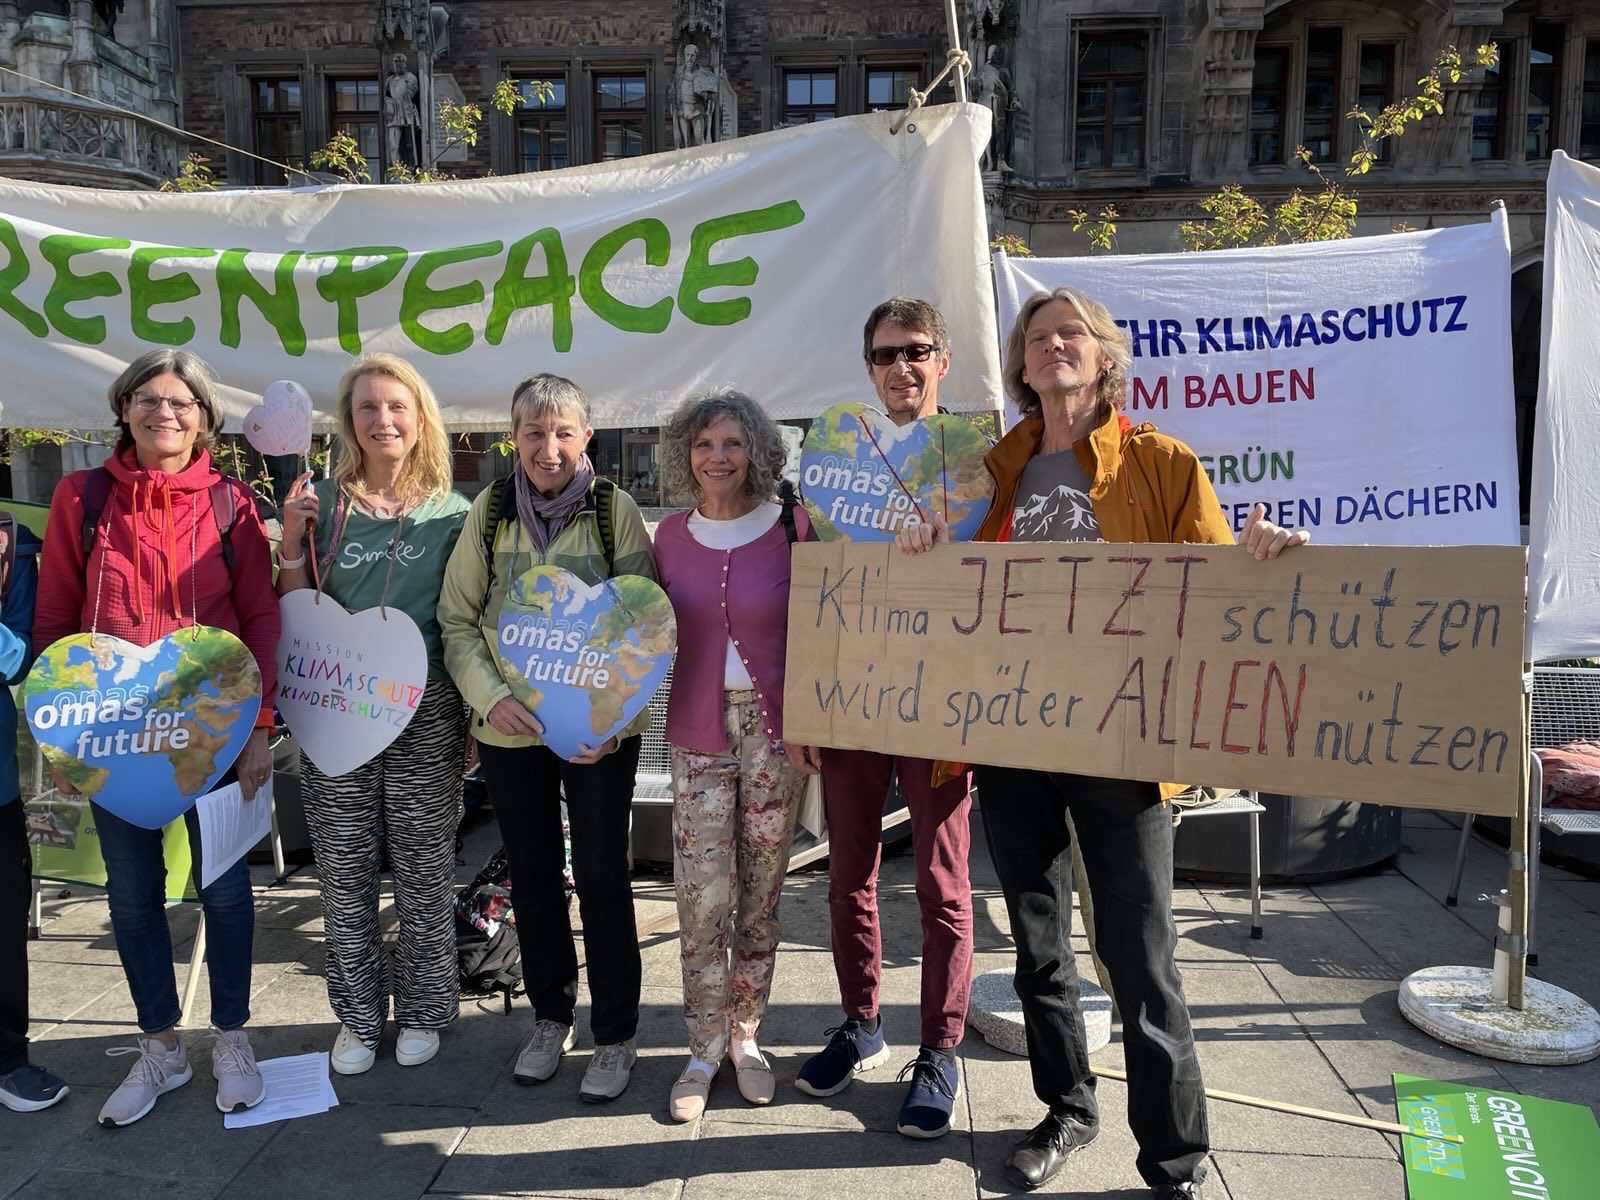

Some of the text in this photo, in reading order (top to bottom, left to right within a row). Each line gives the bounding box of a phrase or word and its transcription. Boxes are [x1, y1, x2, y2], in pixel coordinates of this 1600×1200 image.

[1113, 295, 1468, 358] HR KLIMASCHUTZ
[1184, 367, 1315, 409] BAUEN
[804, 464, 922, 513] omas for
[1335, 481, 1497, 525] DÄCHERN
[829, 496, 921, 531] future
[340, 537, 426, 569] Smile
[814, 556, 1500, 655] Klima JETZT schützen
[293, 638, 364, 663] MISSION
[501, 624, 610, 668] omas for
[284, 653, 424, 709] KLIMASCHUTZ
[523, 653, 610, 689] future
[34, 697, 186, 731] omas for
[280, 685, 409, 728] KINDERSCHUTZ
[814, 655, 1508, 774] wird später ALLEN nützen
[76, 726, 190, 760] future
